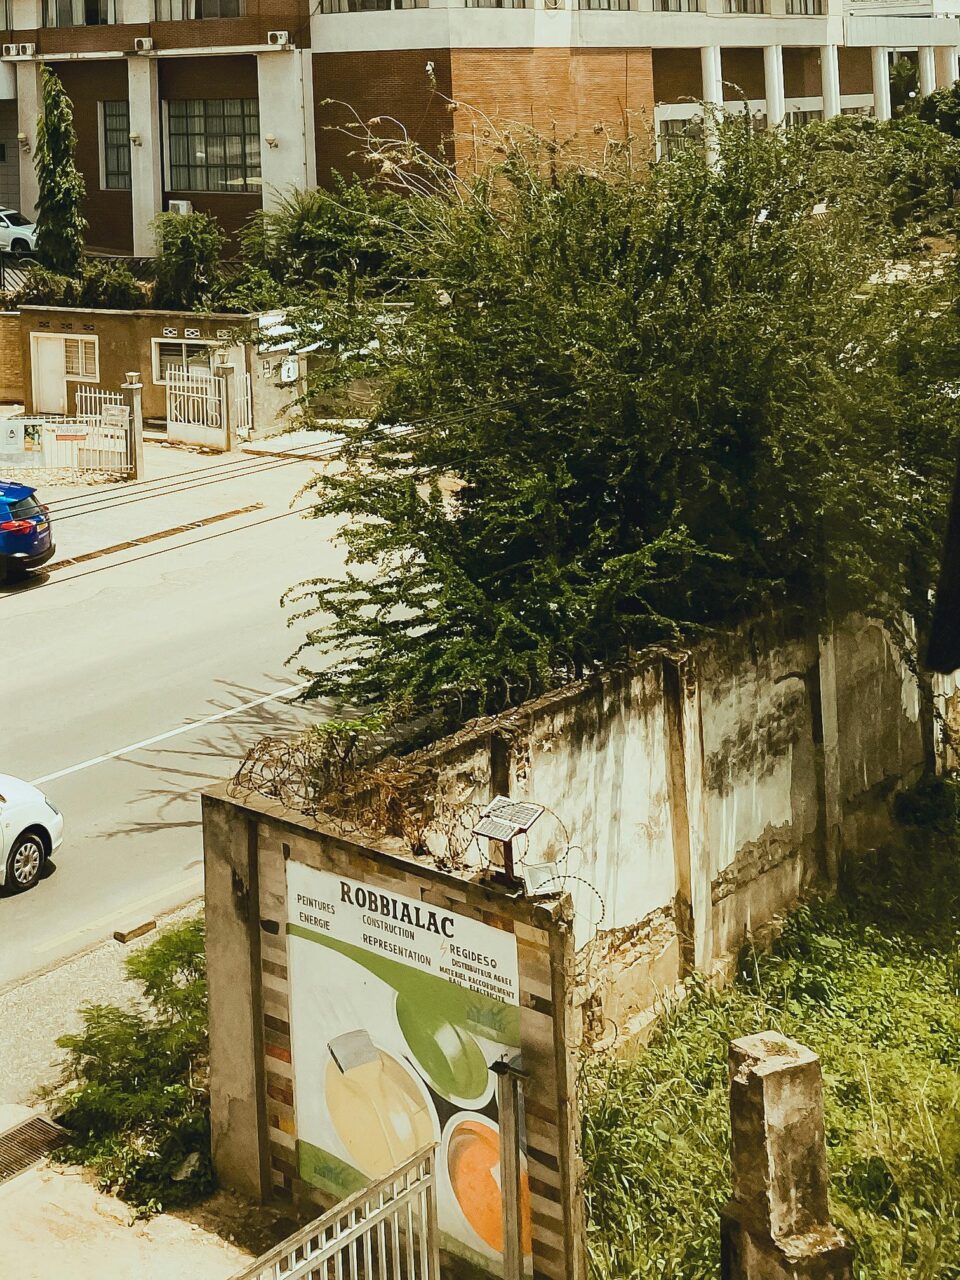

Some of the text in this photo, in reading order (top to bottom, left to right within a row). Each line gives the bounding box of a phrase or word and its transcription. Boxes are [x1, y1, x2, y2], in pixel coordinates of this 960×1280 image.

[297, 893, 336, 915] PEINTURES
[362, 914, 415, 941] CONSTRUCTION
[339, 881, 455, 939] ROBBIALAC
[299, 911, 432, 967] ENERGIE REPRESENTATION
[439, 965, 515, 1000] MATERIEL RACCORDEMENT
[451, 958, 492, 979] DISTRIBUTEUR
